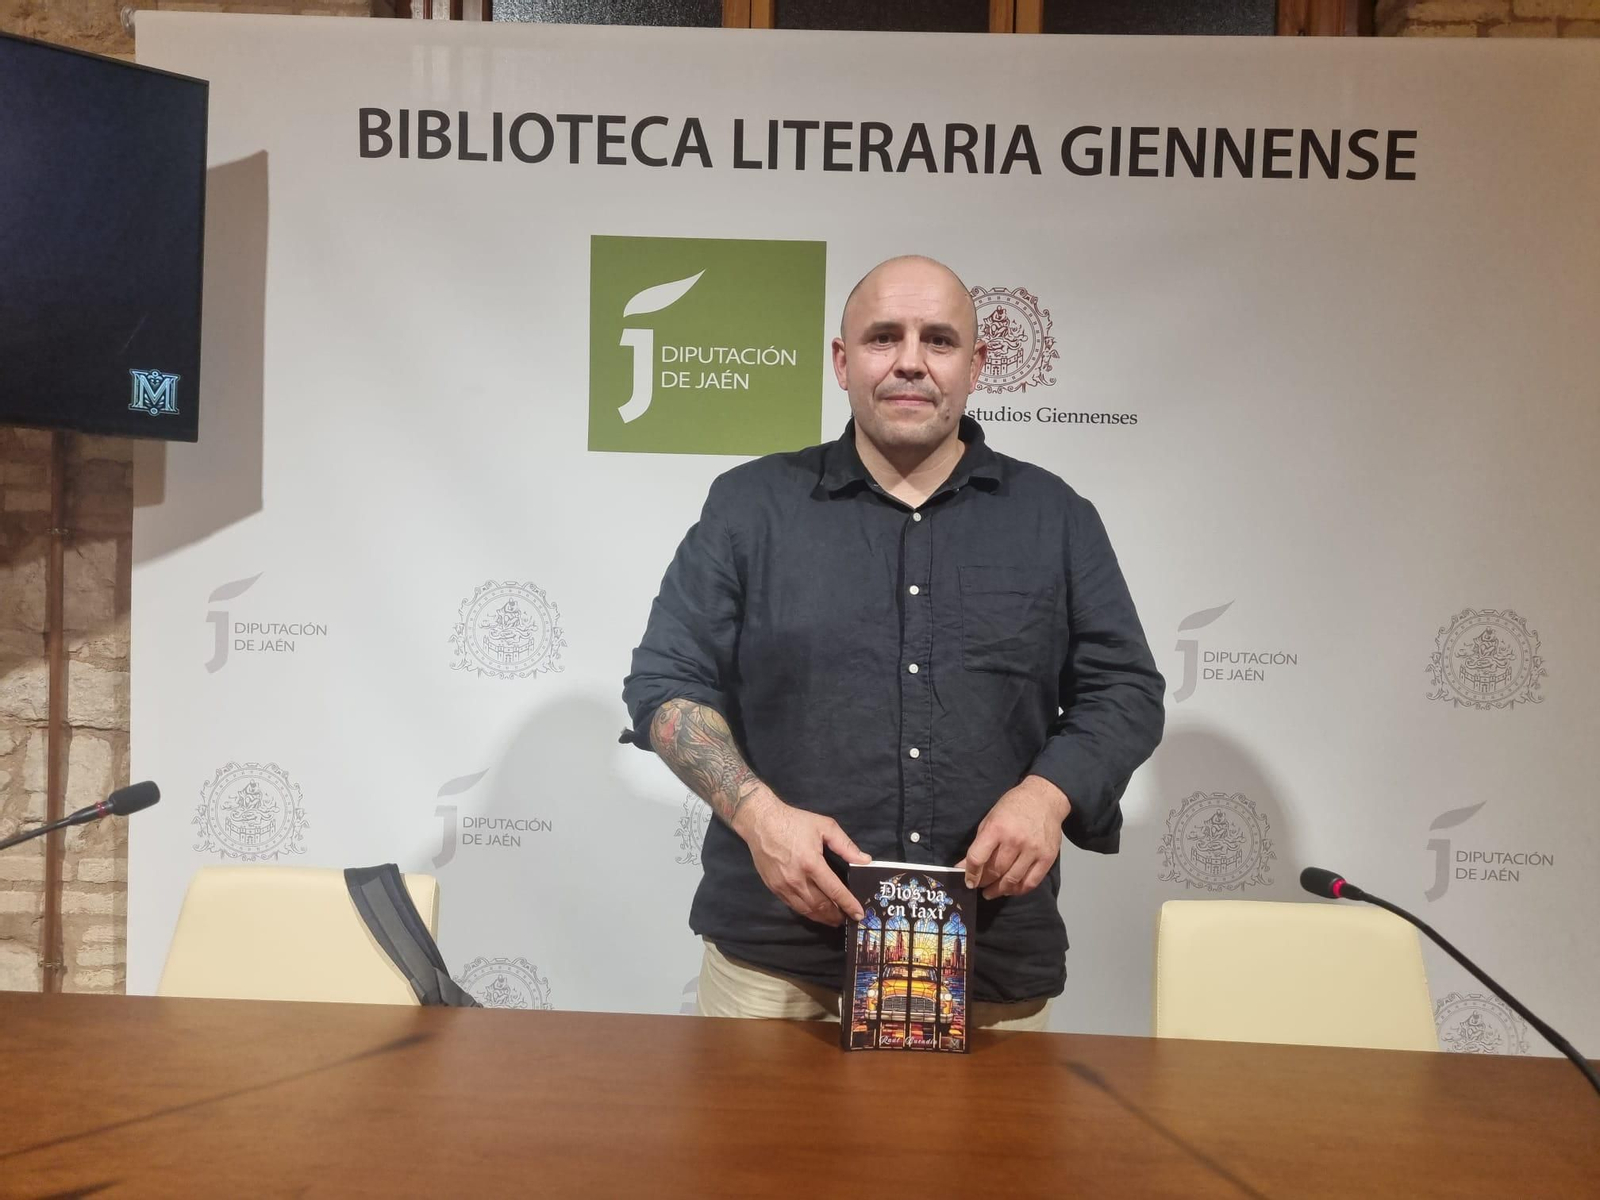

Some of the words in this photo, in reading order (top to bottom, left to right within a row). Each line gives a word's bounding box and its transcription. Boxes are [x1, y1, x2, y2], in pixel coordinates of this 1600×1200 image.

[359, 108, 713, 168] BIBLIOTECA
[733, 118, 1042, 175] LITERARIA
[1060, 125, 1418, 181] GIENNENSE
[661, 345, 797, 366] DIPUTACIÓN
[661, 371, 690, 388] DE
[695, 369, 749, 390] JAÉN
[128, 369, 181, 416] M
[964, 406, 1031, 423] studios
[1036, 406, 1138, 425] Giennenses
[234, 622, 327, 636] DIPUTACIÓN
[234, 639, 255, 651] DE
[258, 638, 295, 652] JAÉN
[1203, 651, 1298, 666] DIPUTACIÓN
[1203, 668, 1224, 680] DE
[1226, 667, 1265, 682] JAÉN
[463, 816, 552, 832] DIPUTACIÓN
[462, 833, 483, 846] DE
[486, 833, 521, 847] JAÉN
[1456, 850, 1554, 867] DIPUTACIÓN
[1455, 867, 1478, 880] DE
[1480, 867, 1520, 882] JAÉN
[879, 880, 921, 900] Dios
[926, 889, 944, 902] va
[887, 904, 906, 917] en
[911, 903, 943, 920] taxi
